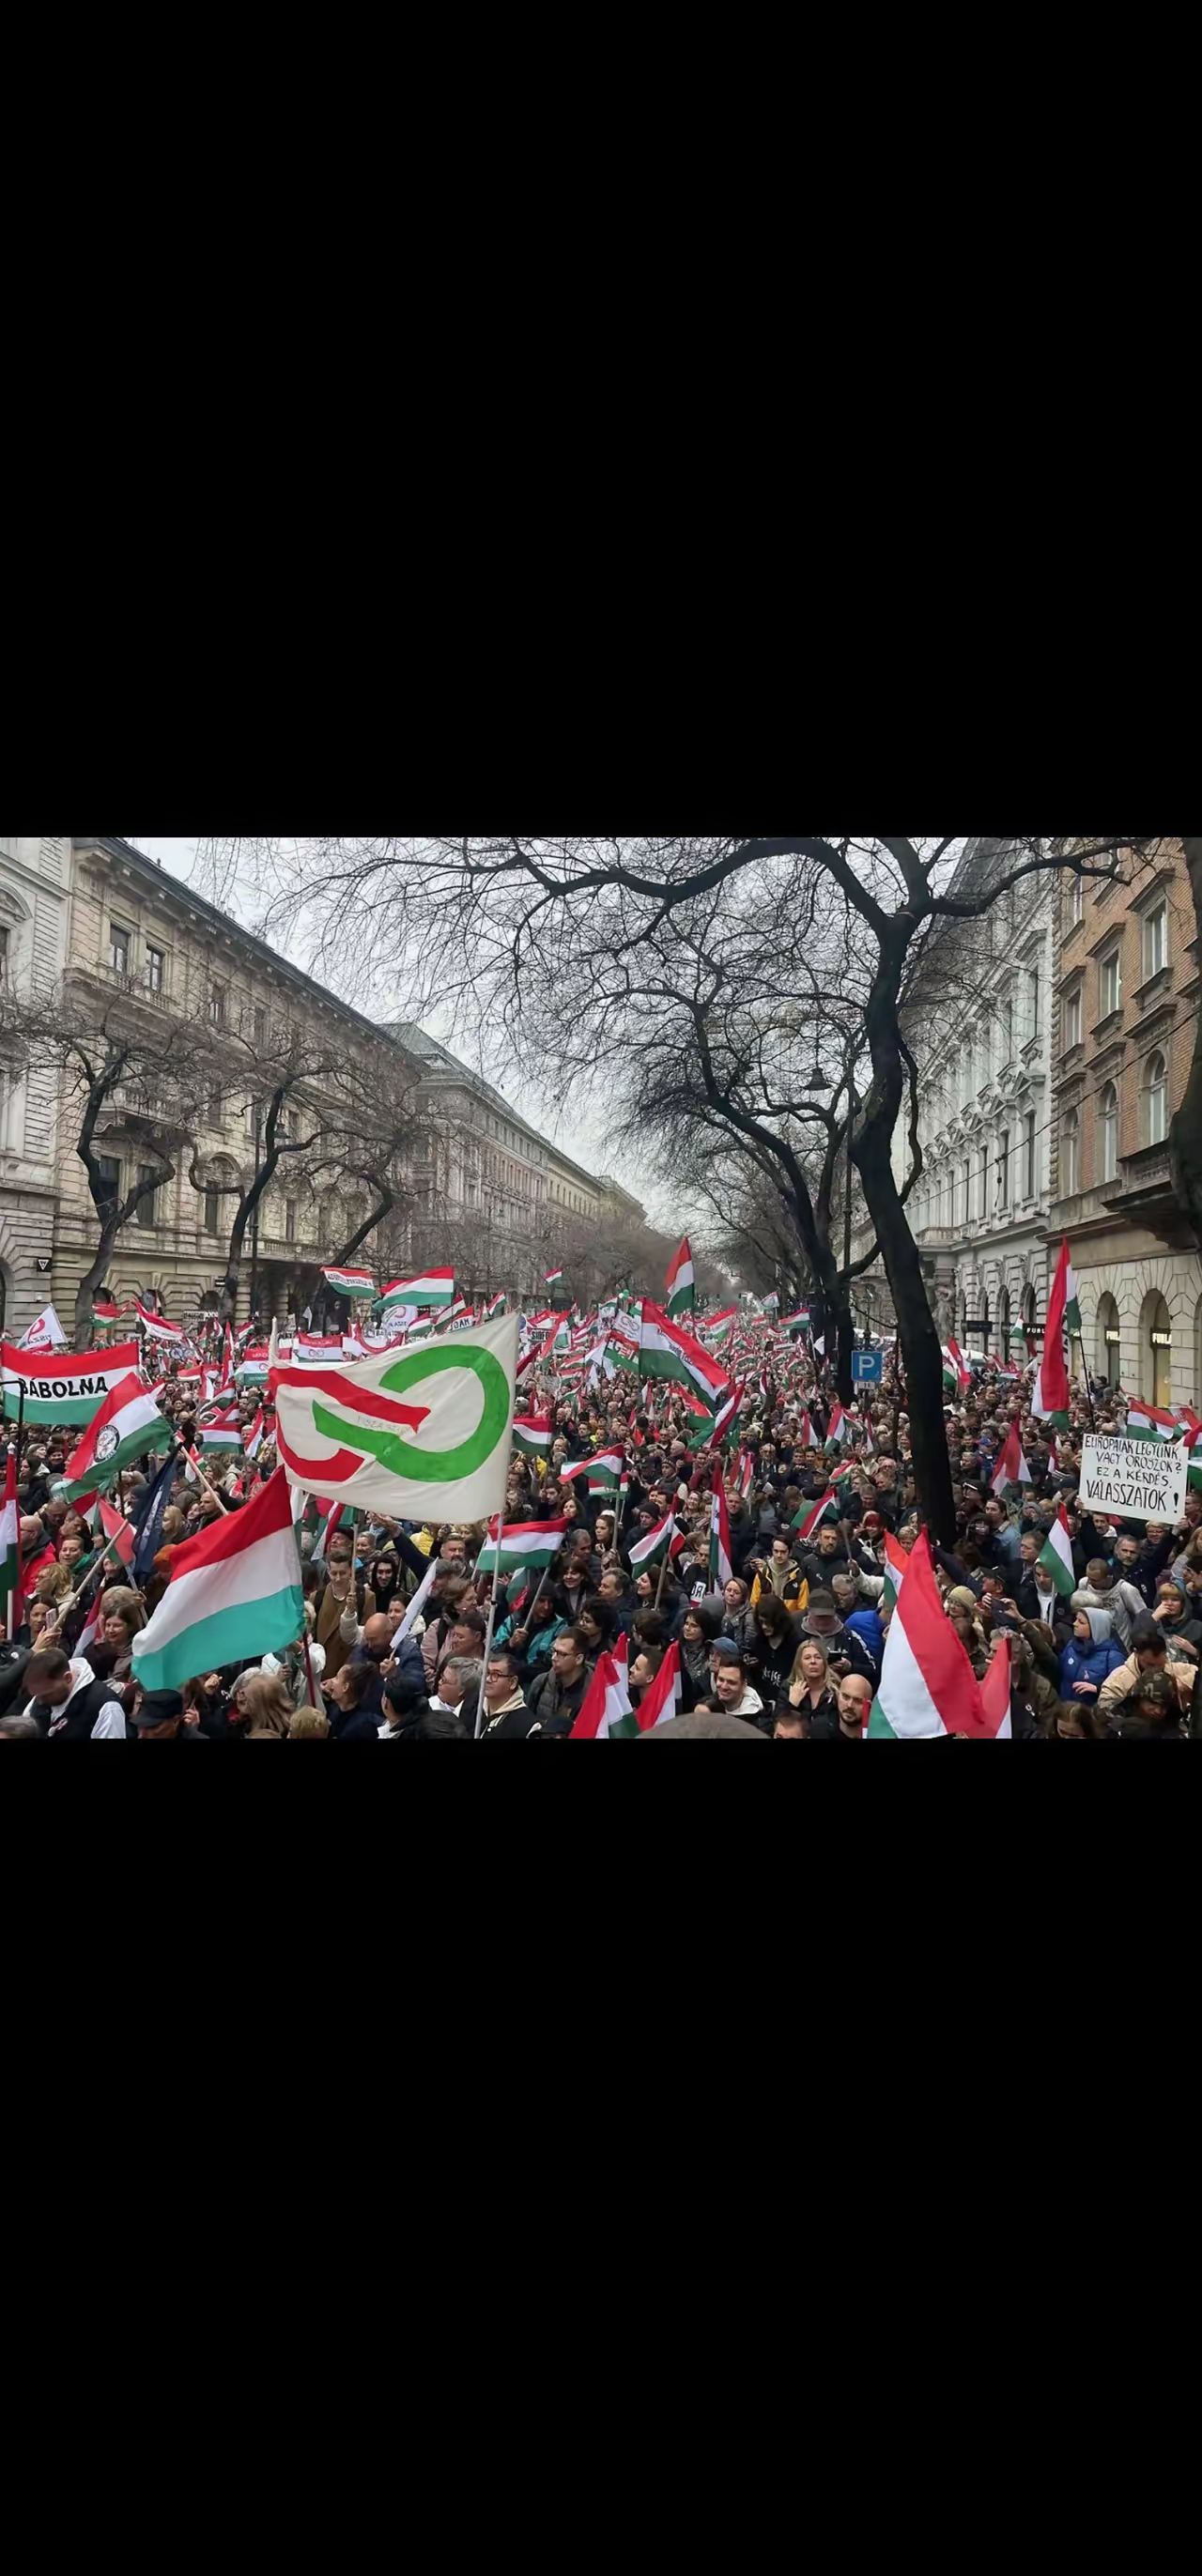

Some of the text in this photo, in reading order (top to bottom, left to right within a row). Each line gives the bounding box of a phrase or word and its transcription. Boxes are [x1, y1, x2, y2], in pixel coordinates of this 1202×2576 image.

[858, 1356, 875, 1377] P
[1096, 1451, 1121, 1464] VAGY
[1097, 1466, 1109, 1476] EZ
[1113, 1468, 1121, 1480] A
